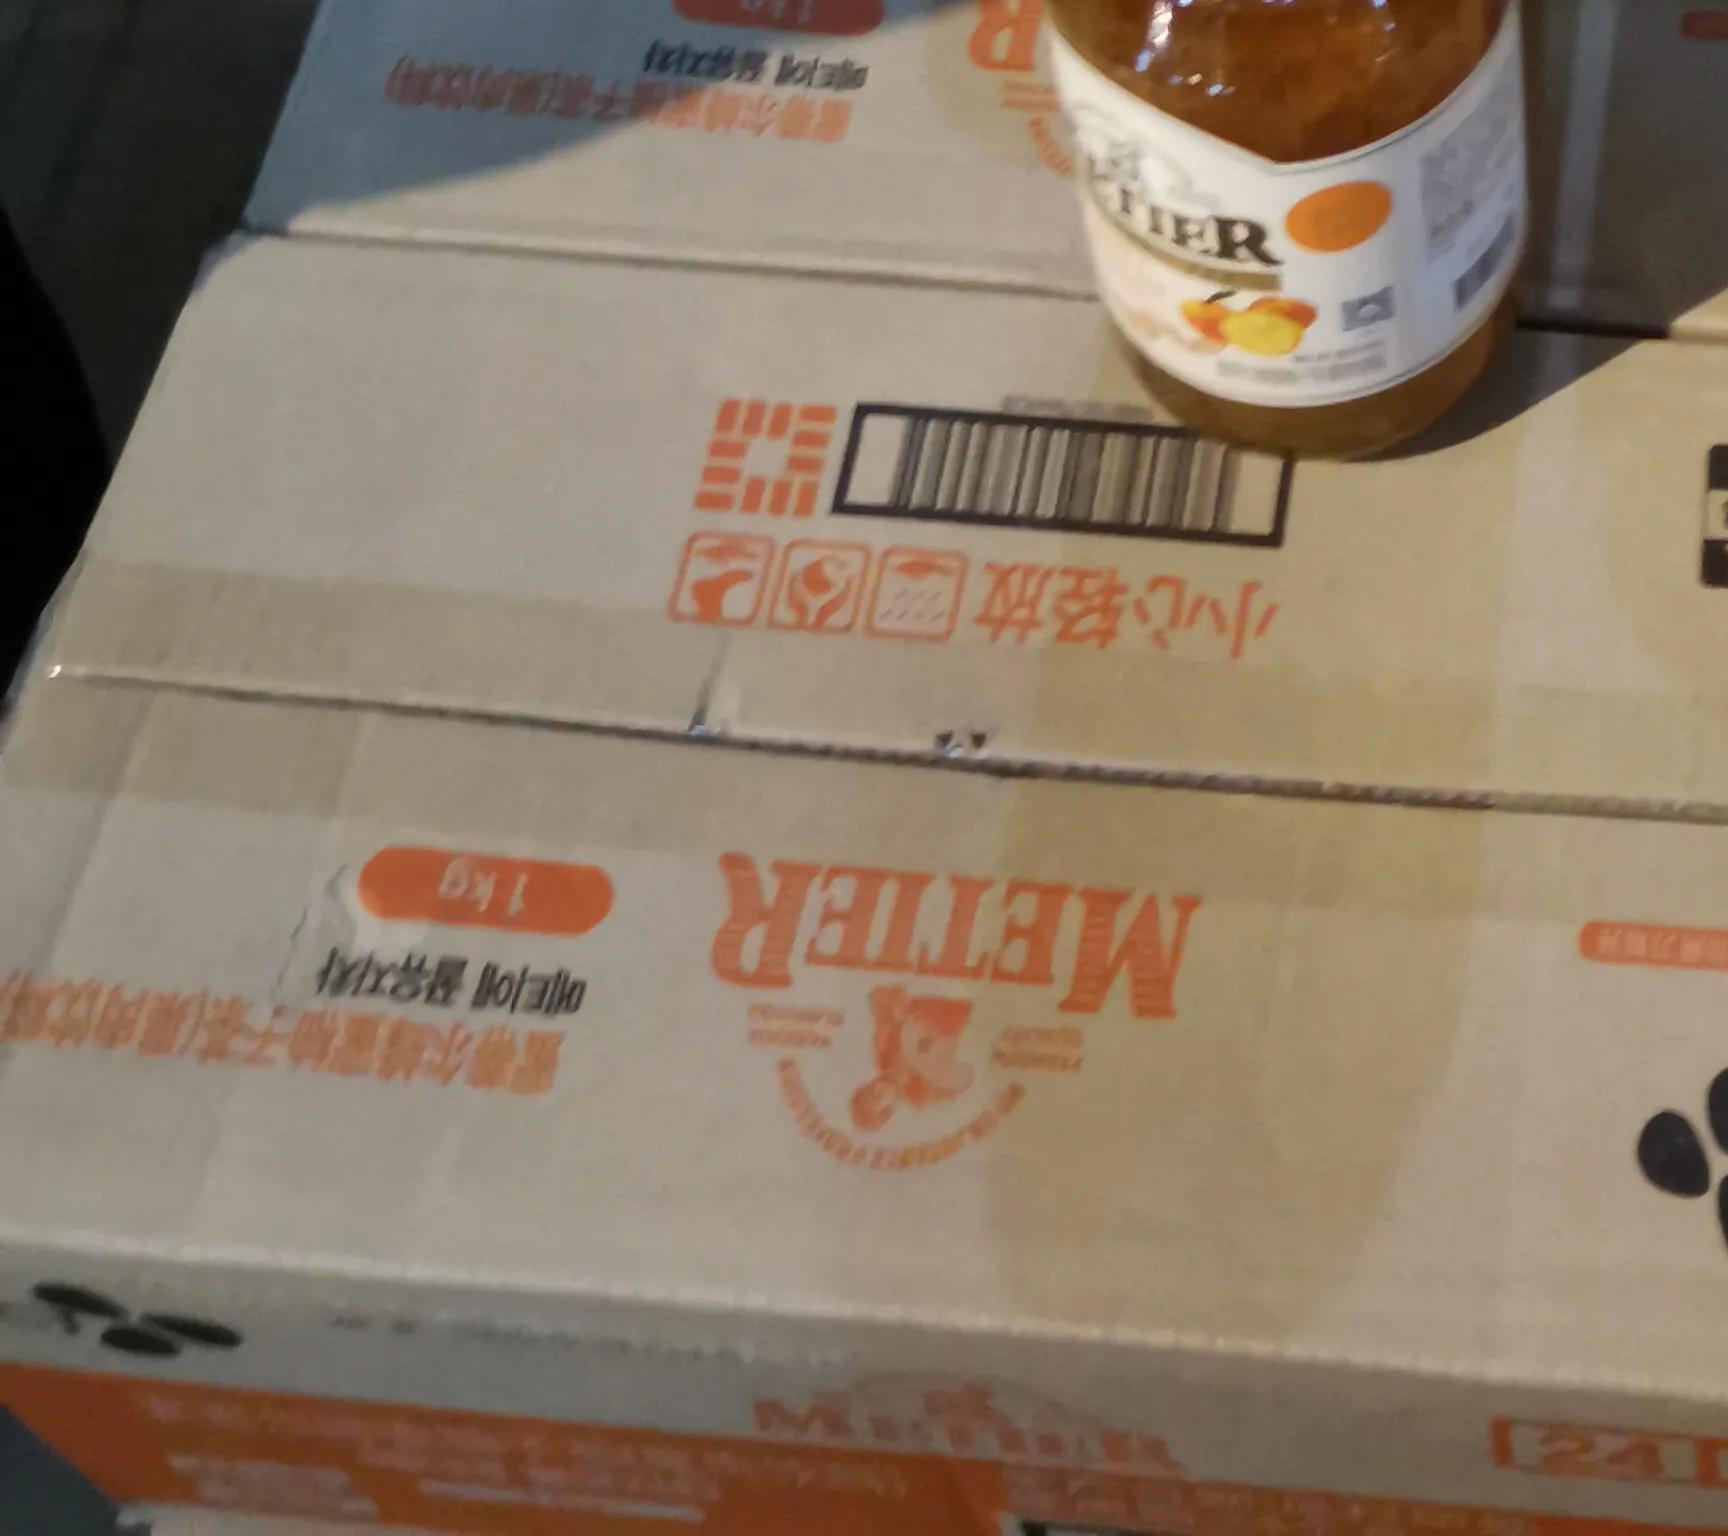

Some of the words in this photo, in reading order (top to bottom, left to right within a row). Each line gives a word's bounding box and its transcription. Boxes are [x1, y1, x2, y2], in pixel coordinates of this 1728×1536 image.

[1087, 153, 1285, 267] TIER
[973, 559, 1280, 659] 小心轻放
[710, 852, 1201, 1020] METIER
